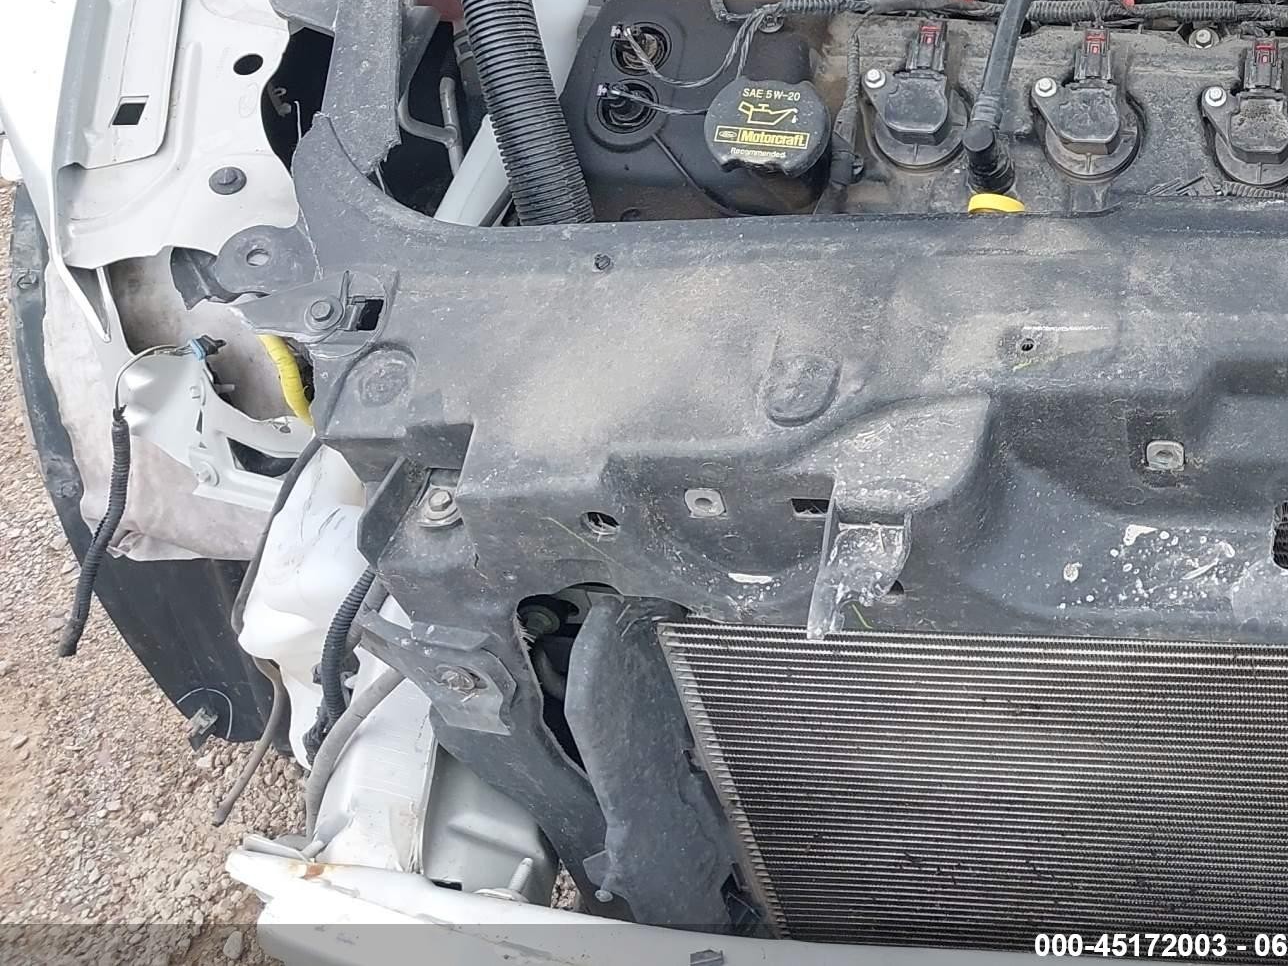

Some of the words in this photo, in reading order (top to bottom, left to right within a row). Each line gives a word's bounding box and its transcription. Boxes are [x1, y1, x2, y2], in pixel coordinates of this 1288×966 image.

[742, 88, 764, 99] SAE
[766, 89, 801, 102] 5W-20
[741, 130, 805, 146] Motorcraft
[730, 147, 786, 158] Recommended
